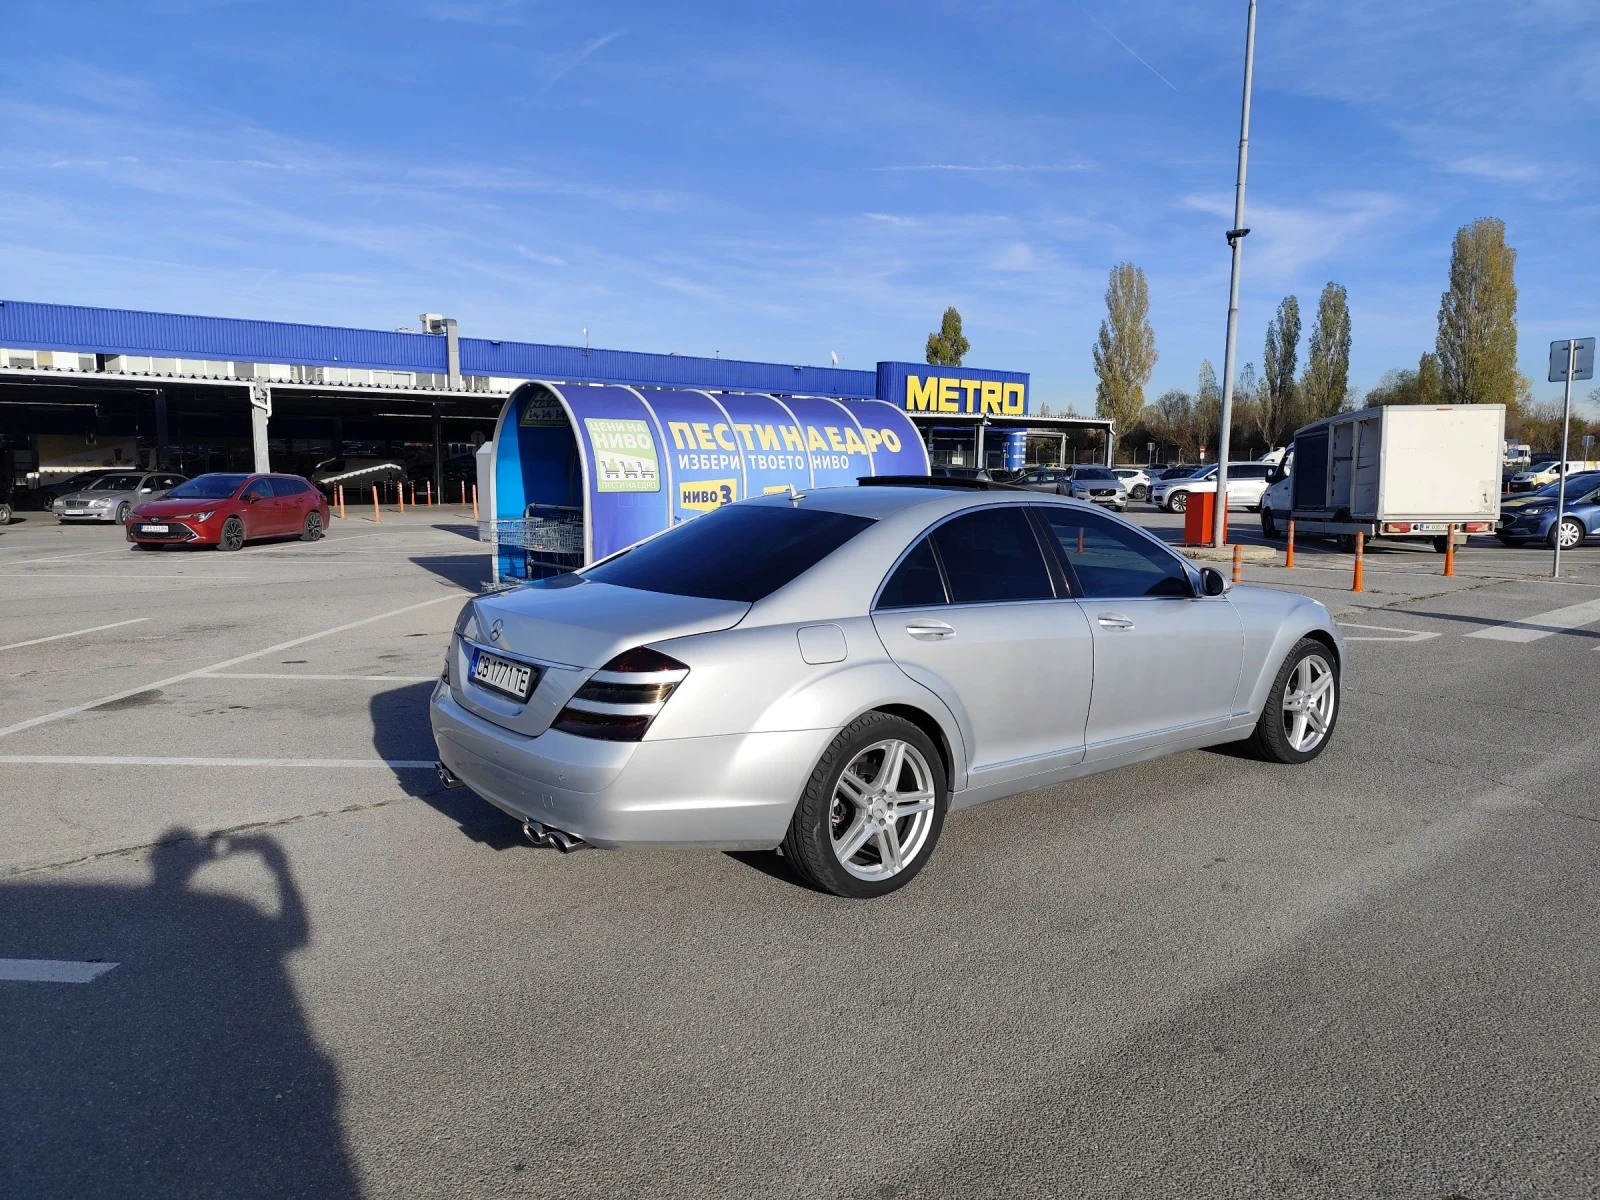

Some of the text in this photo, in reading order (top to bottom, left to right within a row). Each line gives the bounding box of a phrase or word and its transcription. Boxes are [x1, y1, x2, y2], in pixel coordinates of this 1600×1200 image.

[906, 375, 1025, 415] METRO
[588, 421, 646, 433] ЦЕНИ НА
[592, 432, 652, 450] НИВО
[667, 421, 781, 451] ПЕСТИ
[824, 426, 902, 455] ЕДРО
[678, 454, 849, 470] ИЗБЕРИ ТВОЕТО НИВО
[601, 481, 656, 490] ПЕСТИ НА ЕДРО
[682, 484, 733, 506] НИВО 3
[476, 655, 491, 678] CB
[490, 660, 514, 687] 1771
[514, 667, 529, 694] TE
